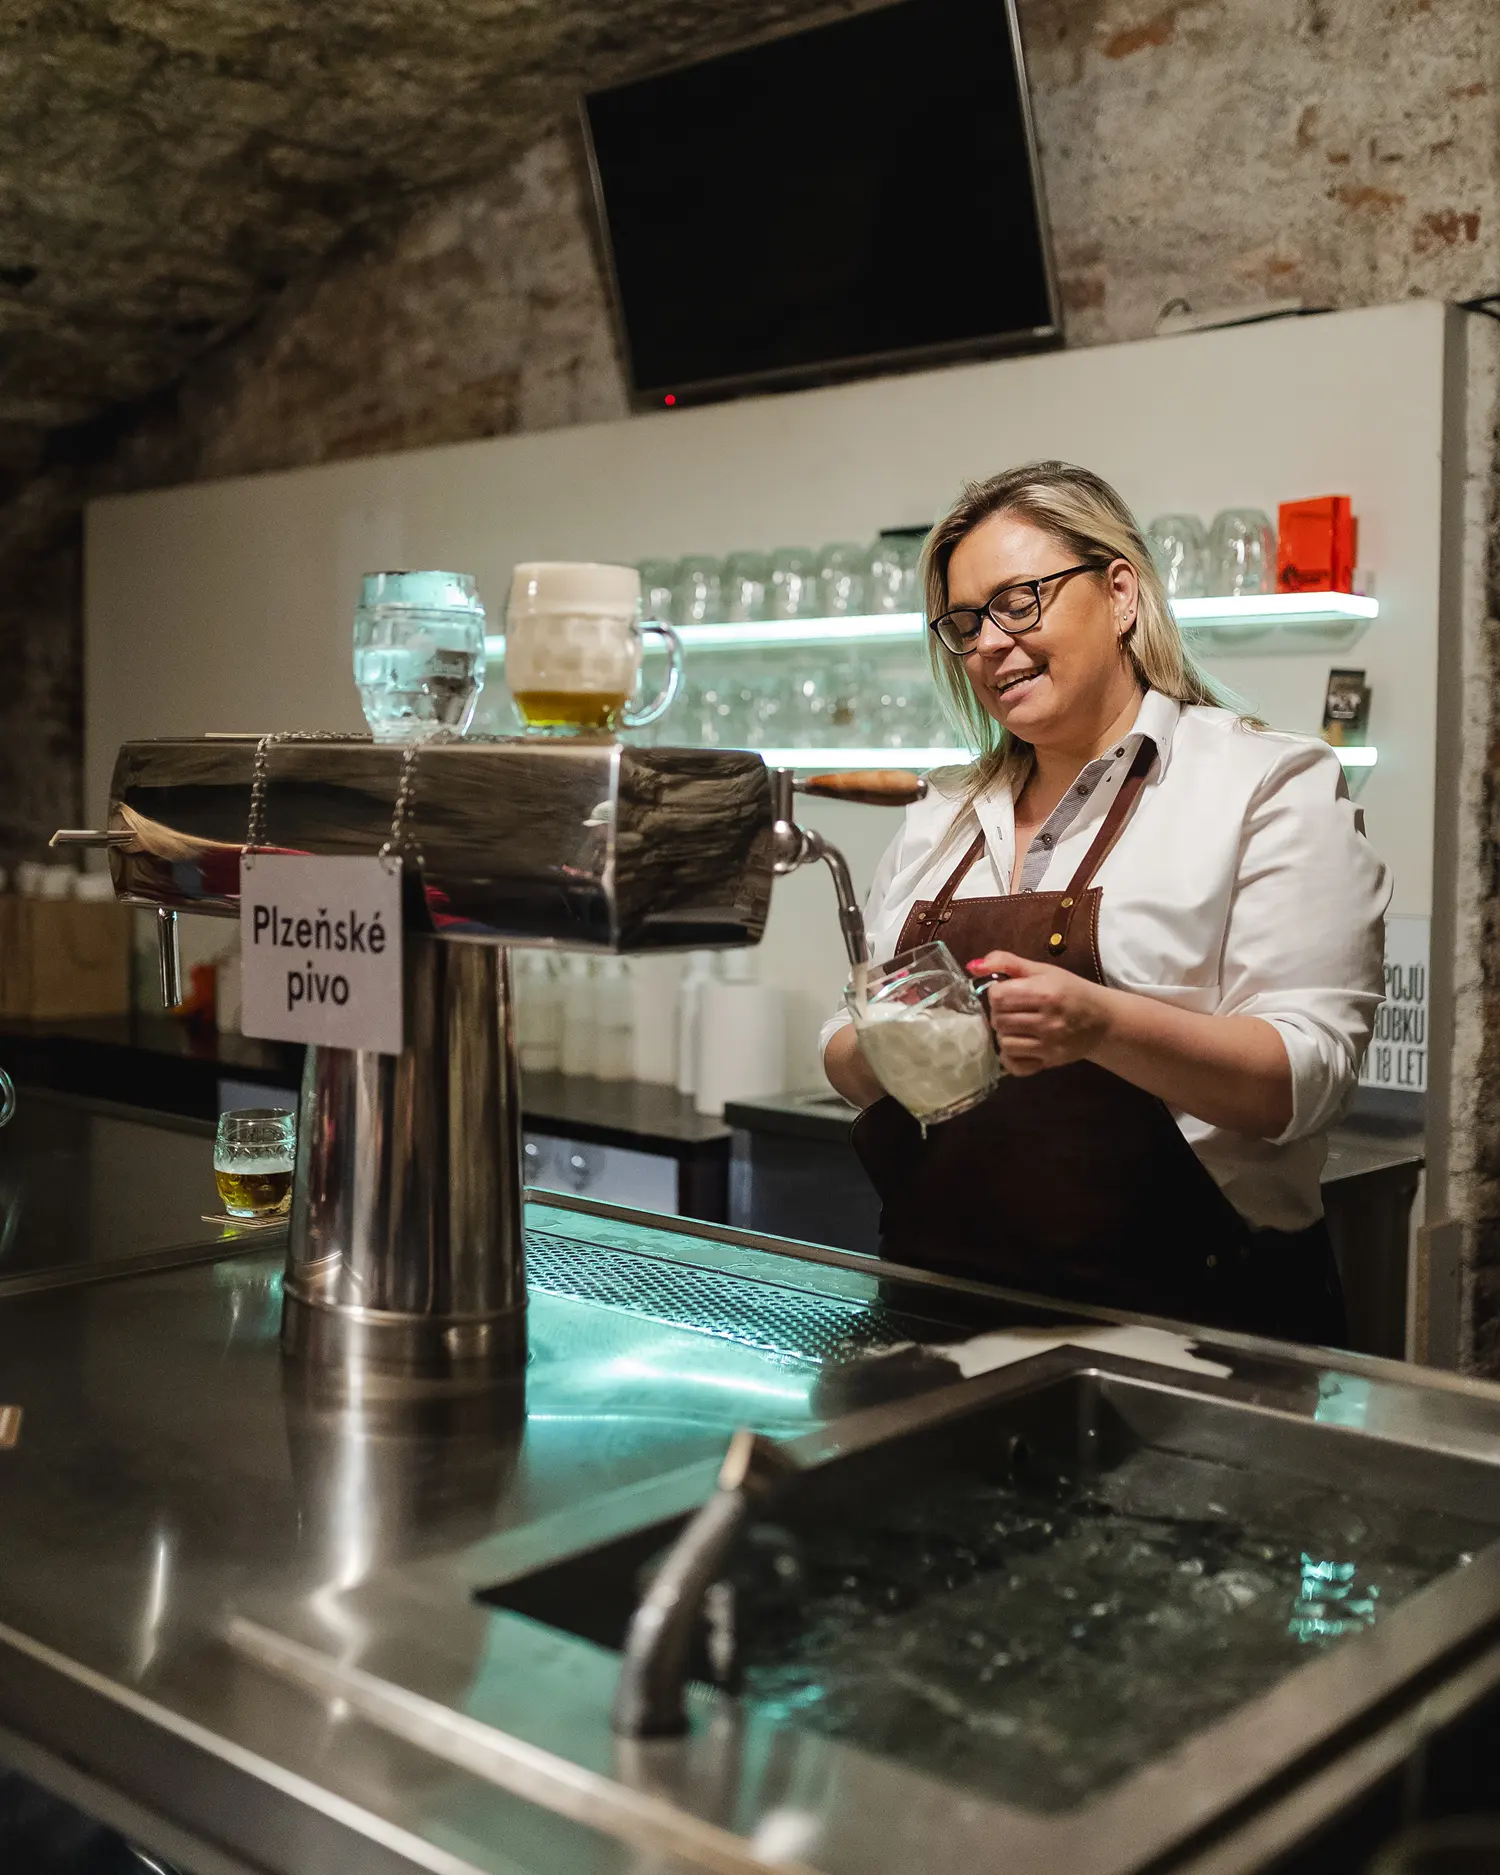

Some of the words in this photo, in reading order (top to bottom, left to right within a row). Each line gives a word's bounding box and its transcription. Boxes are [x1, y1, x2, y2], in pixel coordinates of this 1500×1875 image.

[253, 904, 386, 954] Plzeňské
[287, 959, 350, 1012] pivo
[1376, 1047, 1391, 1082] 18
[1397, 1048, 1426, 1086] LET
